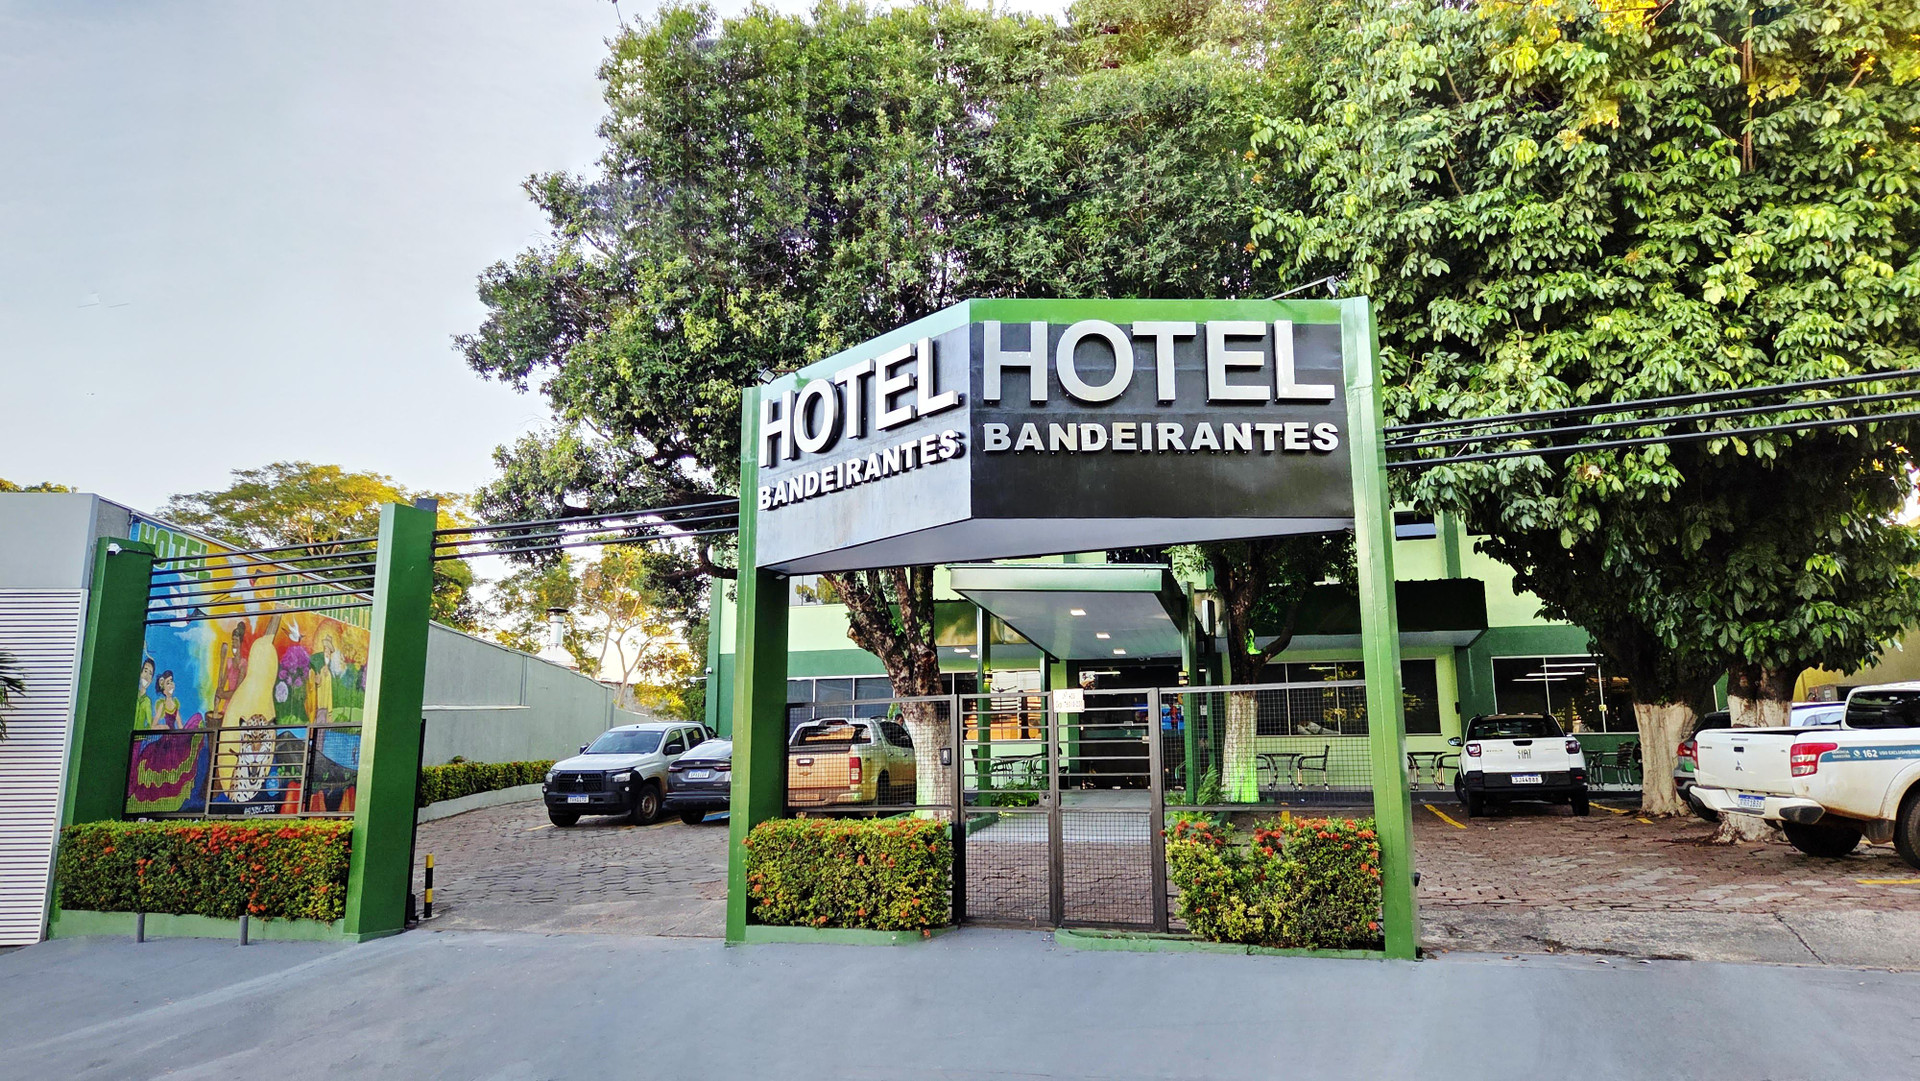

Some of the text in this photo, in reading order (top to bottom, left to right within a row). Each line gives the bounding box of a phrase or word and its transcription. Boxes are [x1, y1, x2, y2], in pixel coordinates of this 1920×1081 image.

[984, 319, 1335, 402] HOTEL
[759, 337, 959, 468] HOTEL
[984, 422, 1339, 452] BANDEIRANTES
[758, 429, 962, 511] BANDEIRANTES
[1862, 749, 1878, 758] 162
